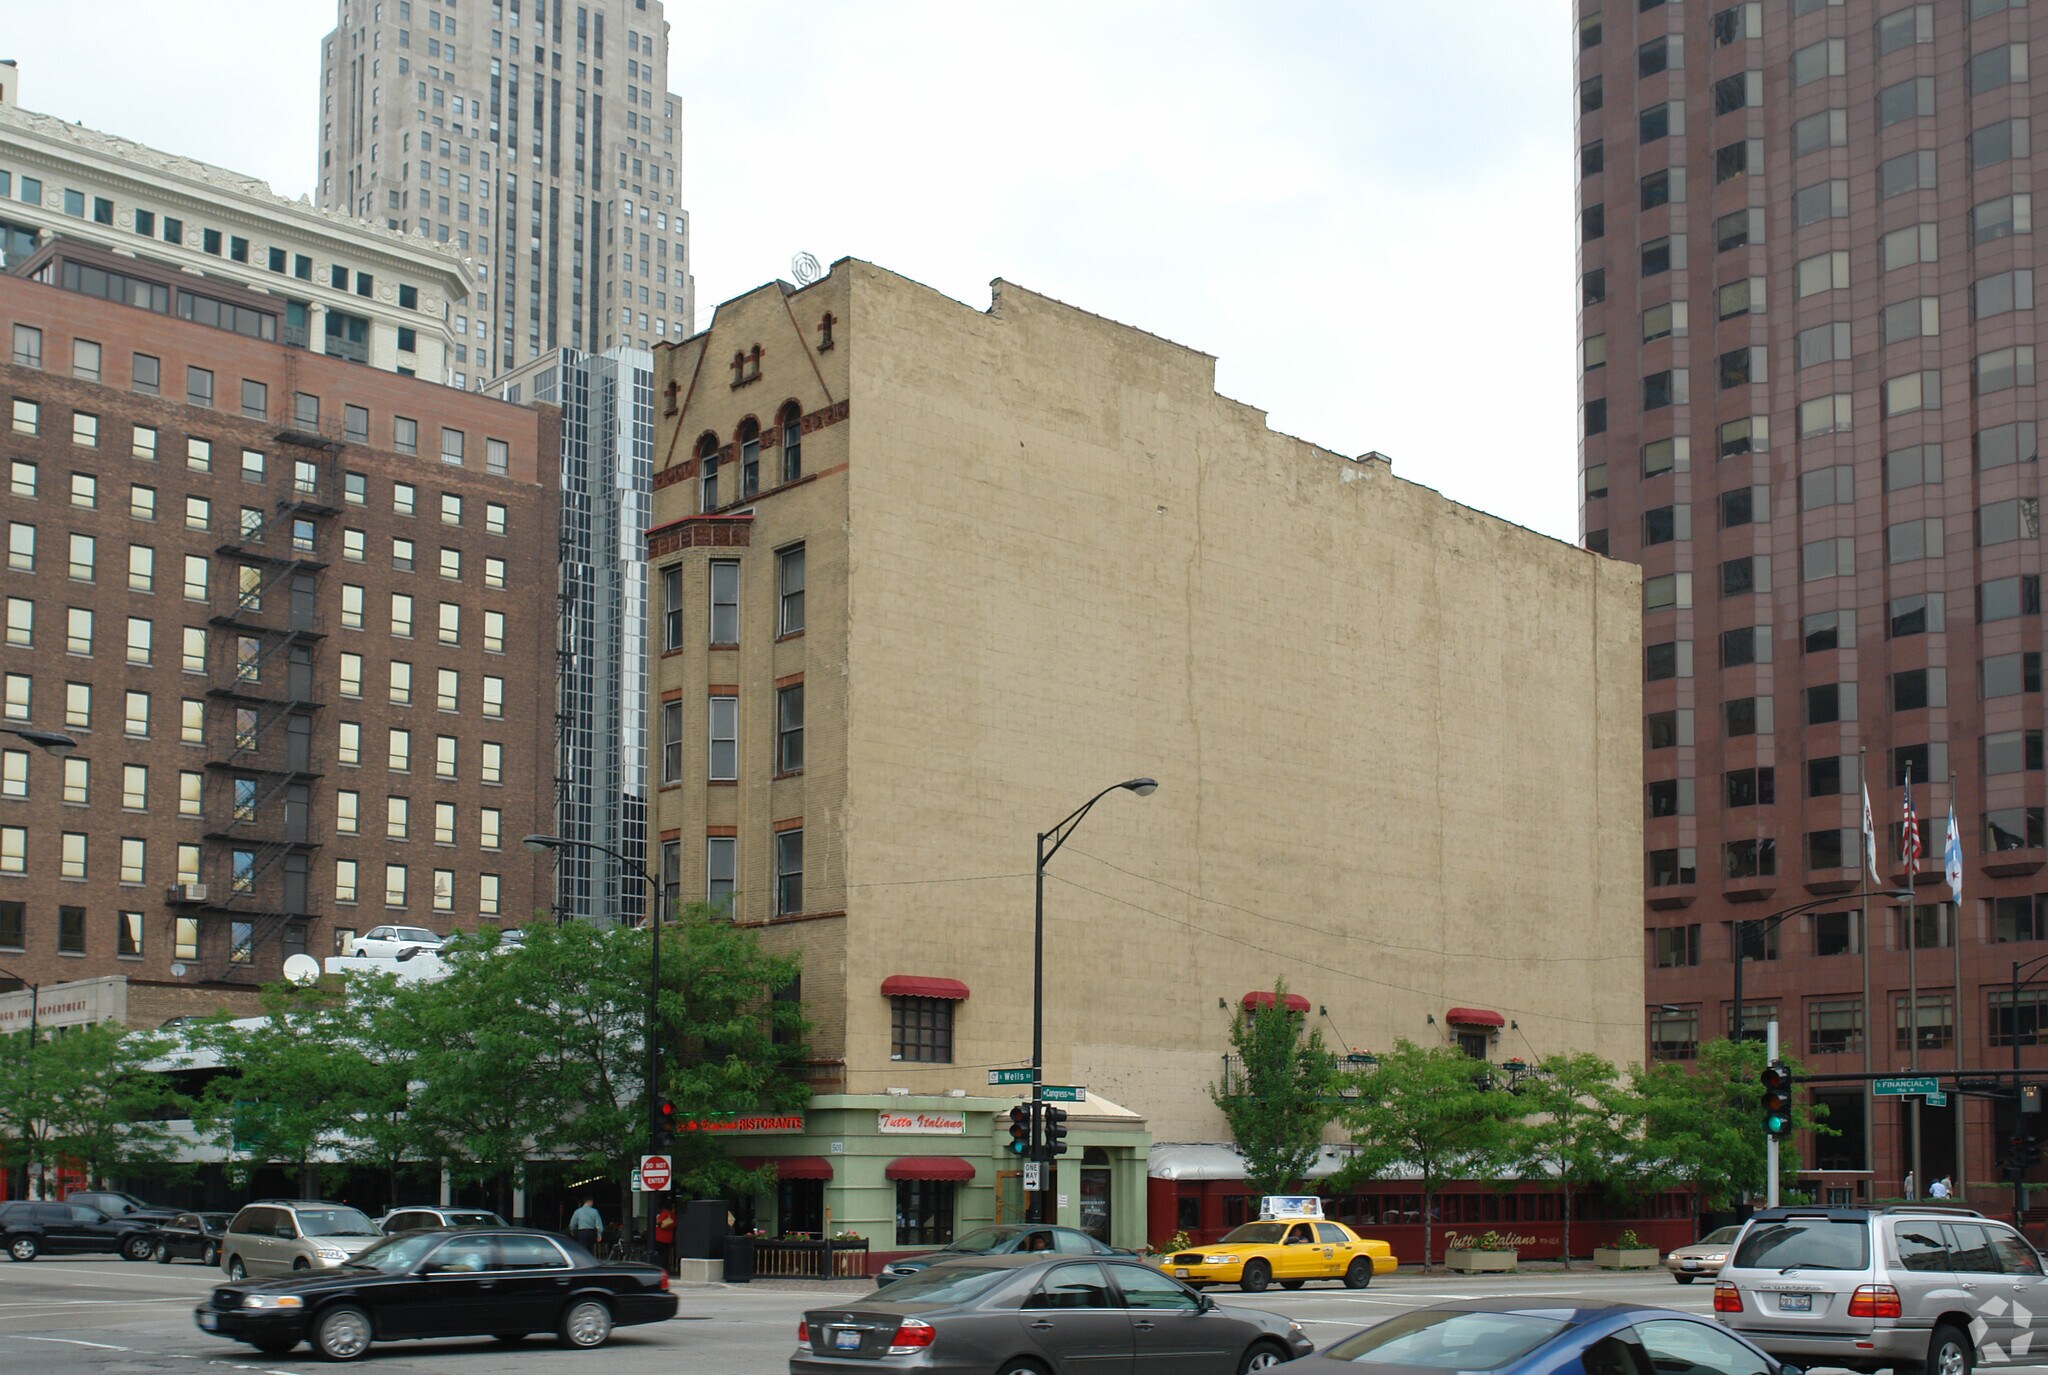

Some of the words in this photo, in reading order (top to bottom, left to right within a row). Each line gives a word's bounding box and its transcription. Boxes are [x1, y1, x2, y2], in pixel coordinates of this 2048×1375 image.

[38, 1001, 86, 1016] DEPARTMENT
[1004, 1072, 1024, 1080] Wells
[1882, 1080, 1924, 1088] FINANCIAL
[1046, 1089, 1068, 1099] Congress
[738, 1116, 802, 1131] RISTORANTE
[880, 1113, 912, 1128] Tutto
[917, 1114, 963, 1129] Italiano
[832, 1143, 842, 1152] 501
